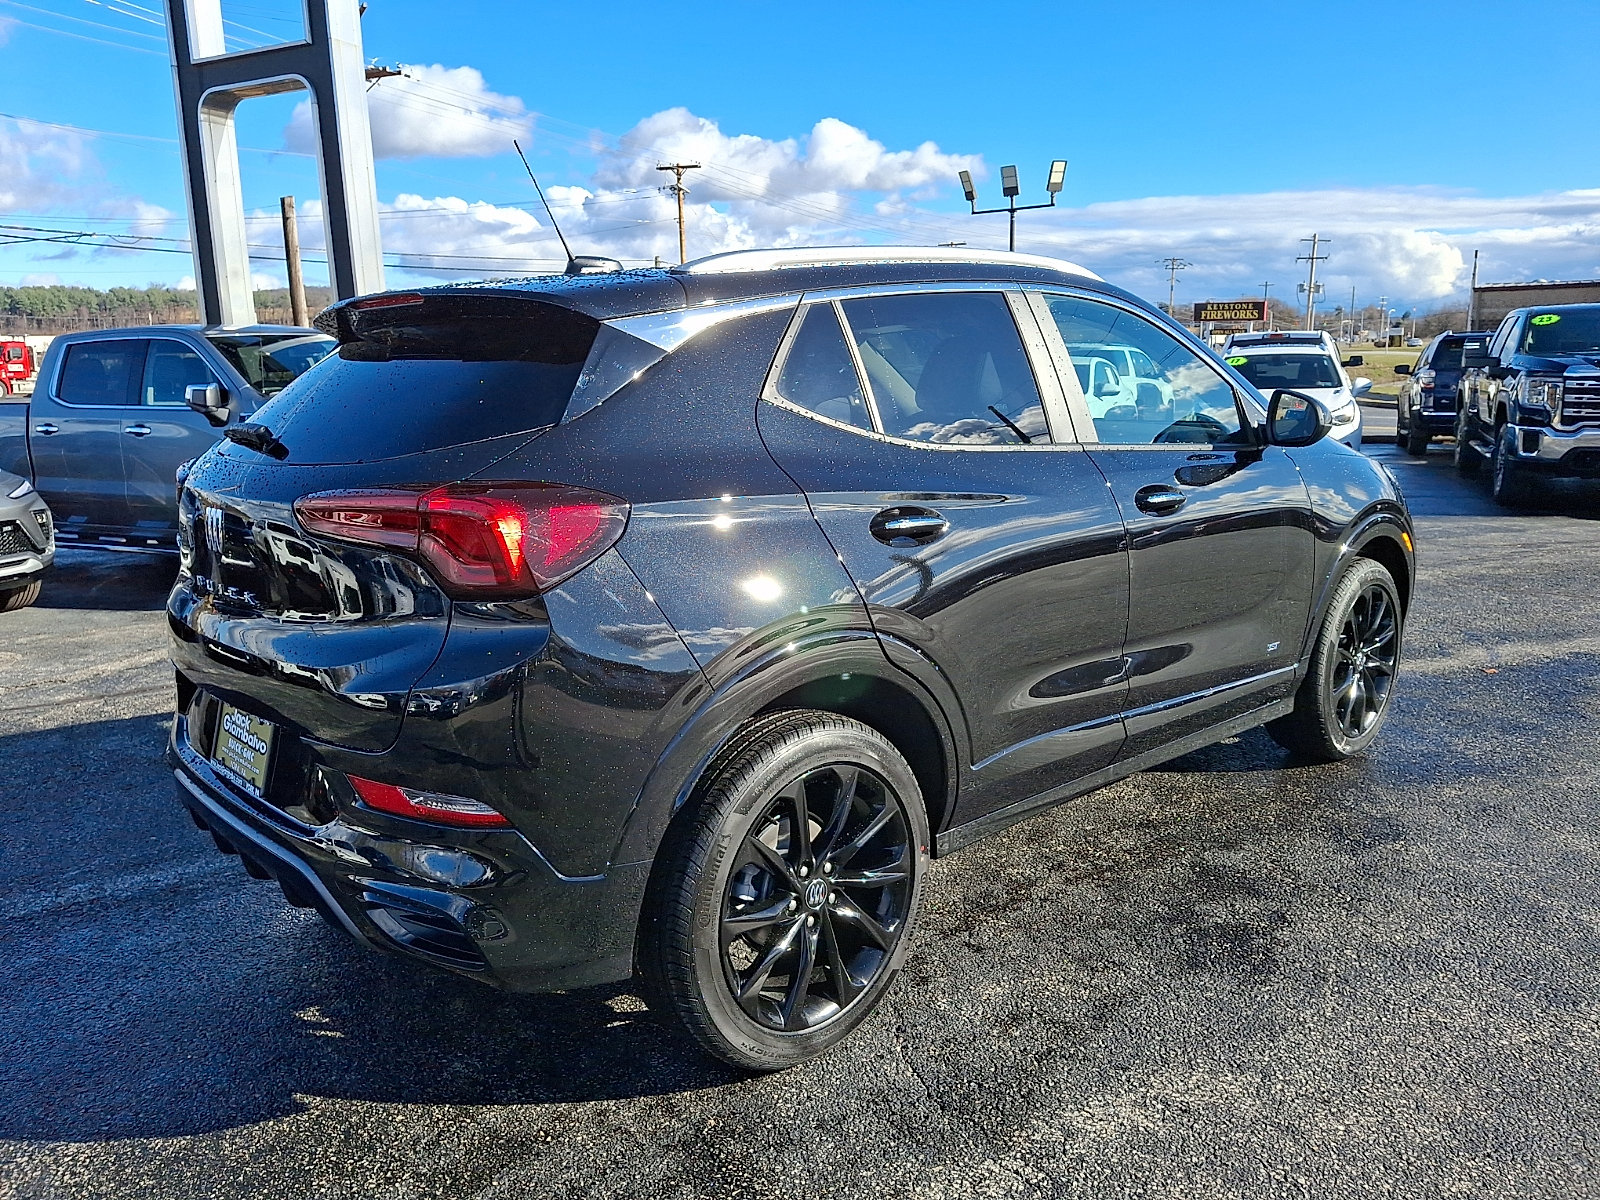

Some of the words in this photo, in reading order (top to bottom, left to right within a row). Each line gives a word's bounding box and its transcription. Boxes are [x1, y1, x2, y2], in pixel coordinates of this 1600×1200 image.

[1201, 310, 1259, 319] FIREWORKS
[231, 708, 251, 731] Jack
[223, 714, 267, 754] Giambalvo
